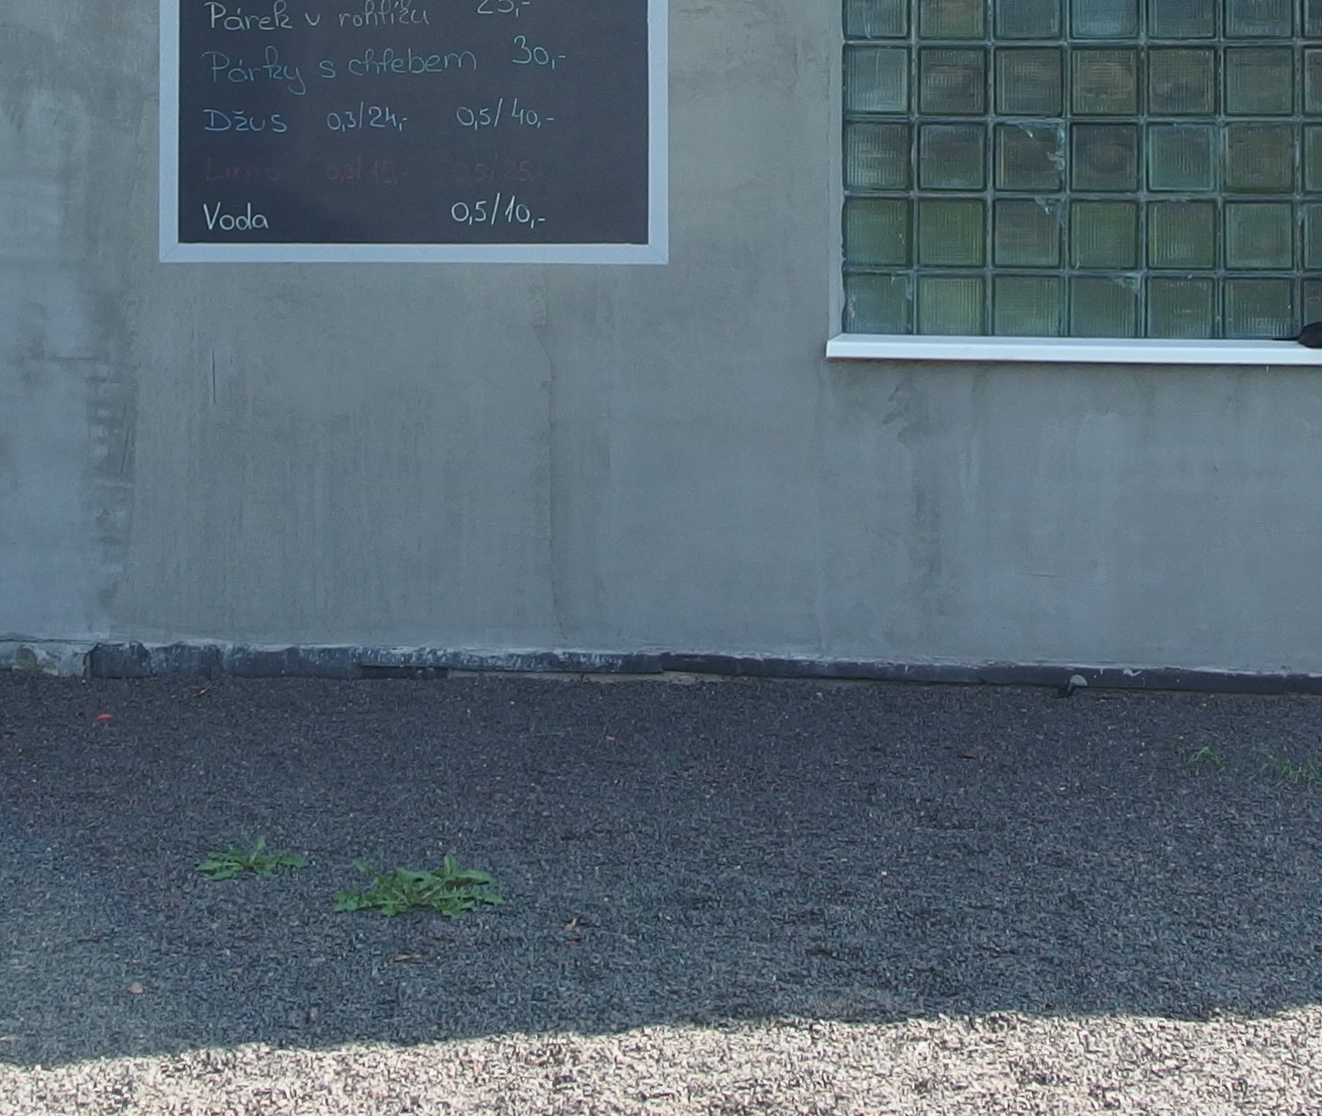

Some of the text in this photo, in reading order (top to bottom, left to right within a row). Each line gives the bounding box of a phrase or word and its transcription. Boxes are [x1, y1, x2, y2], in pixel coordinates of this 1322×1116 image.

[204, 0, 293, 31] Párek
[304, 12, 321, 27] v
[201, 35, 567, 95] Párky s chlebem 30,-
[202, 108, 289, 134] Džus
[203, 201, 270, 231] Voda
